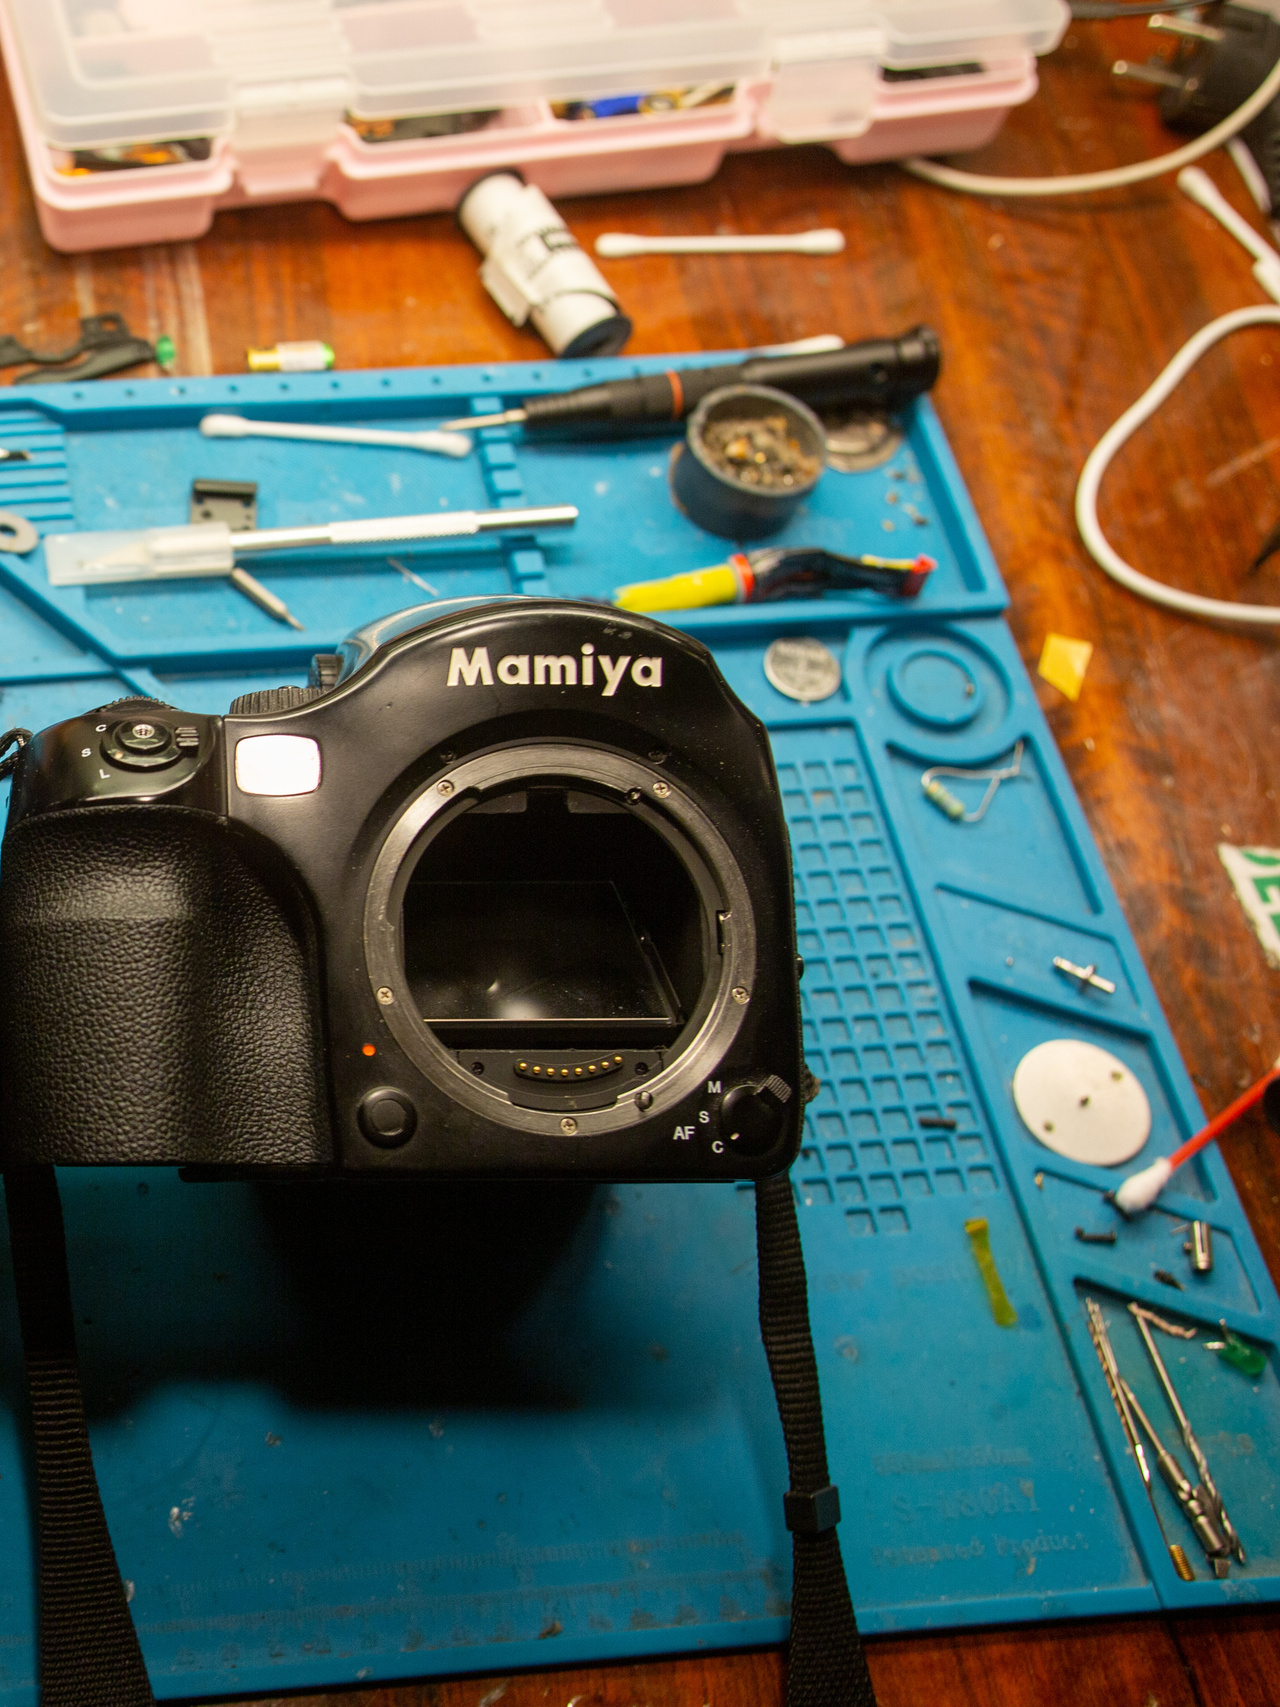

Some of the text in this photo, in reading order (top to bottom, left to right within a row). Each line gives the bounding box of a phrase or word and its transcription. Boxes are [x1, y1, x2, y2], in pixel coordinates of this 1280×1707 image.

[446, 642, 663, 697] Mamiya
[95, 724, 107, 732] C
[81, 748, 92, 758] S
[99, 769, 111, 780] L
[707, 1081, 722, 1094] M
[699, 1111, 711, 1124] S
[673, 1126, 696, 1140] AF
[712, 1141, 725, 1154] C
